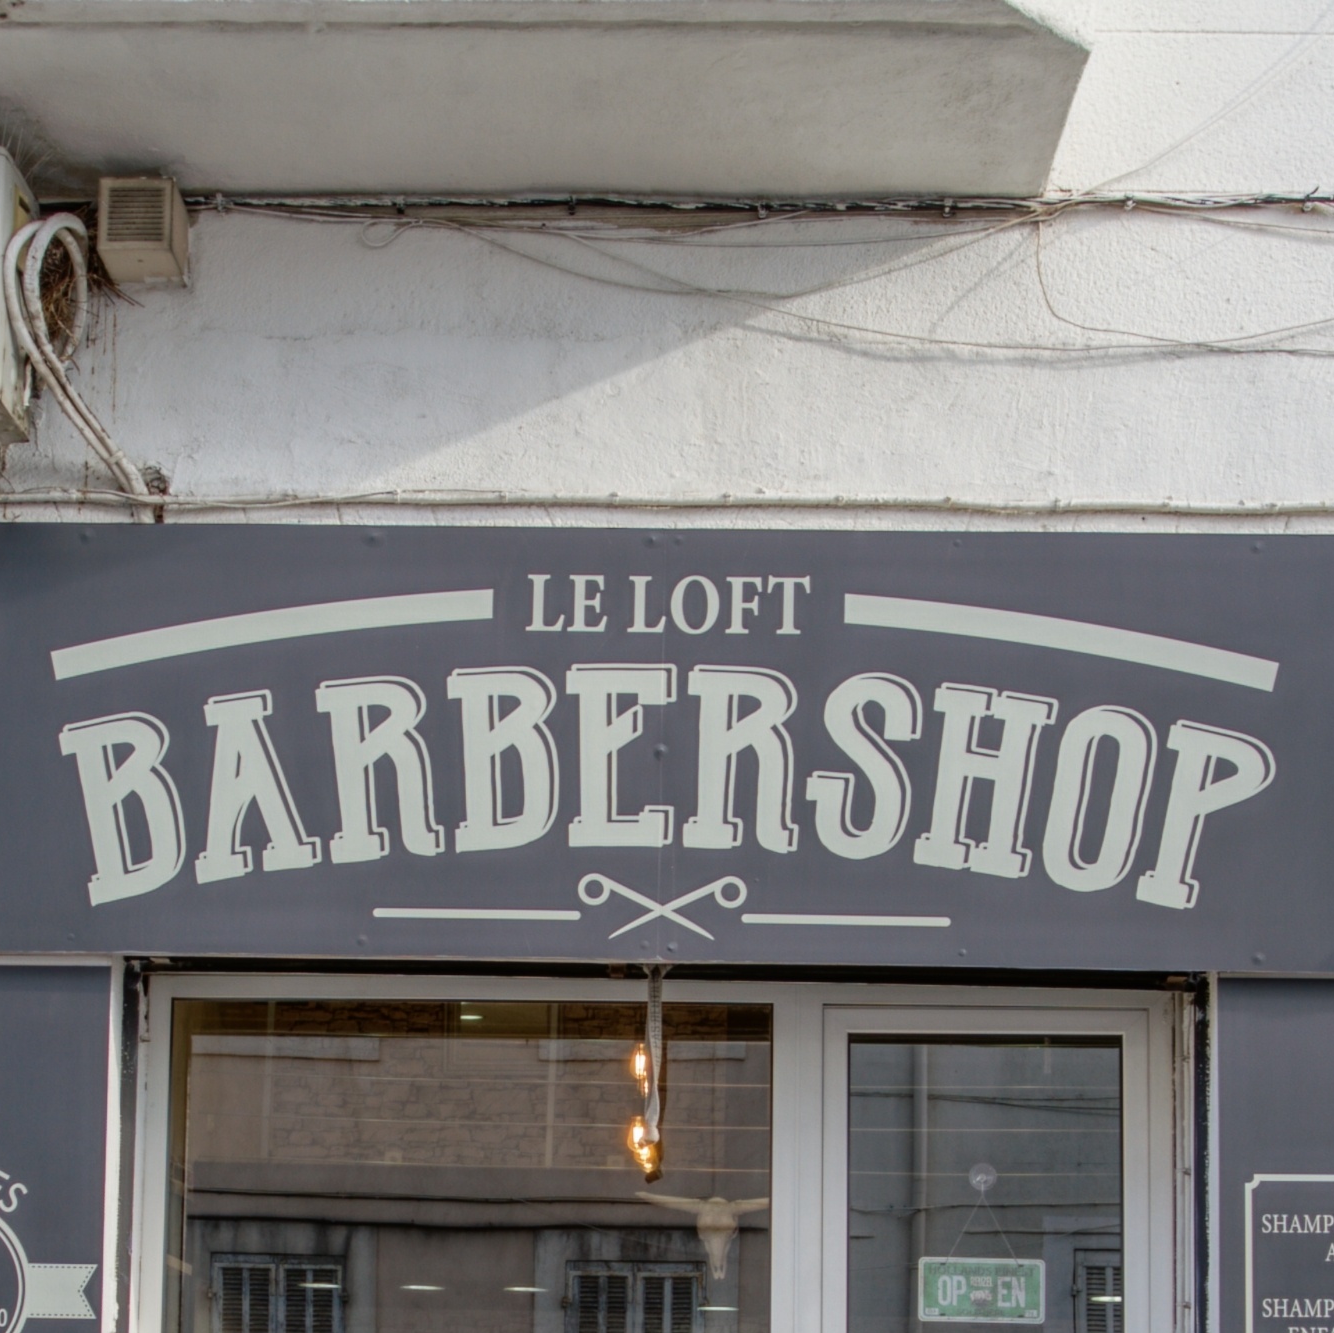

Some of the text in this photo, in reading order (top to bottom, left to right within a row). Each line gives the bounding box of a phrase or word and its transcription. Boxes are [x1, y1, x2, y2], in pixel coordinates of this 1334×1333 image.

[525, 574, 811, 634] LE LOFT
[58, 663, 1276, 910] BARBERSHOP
